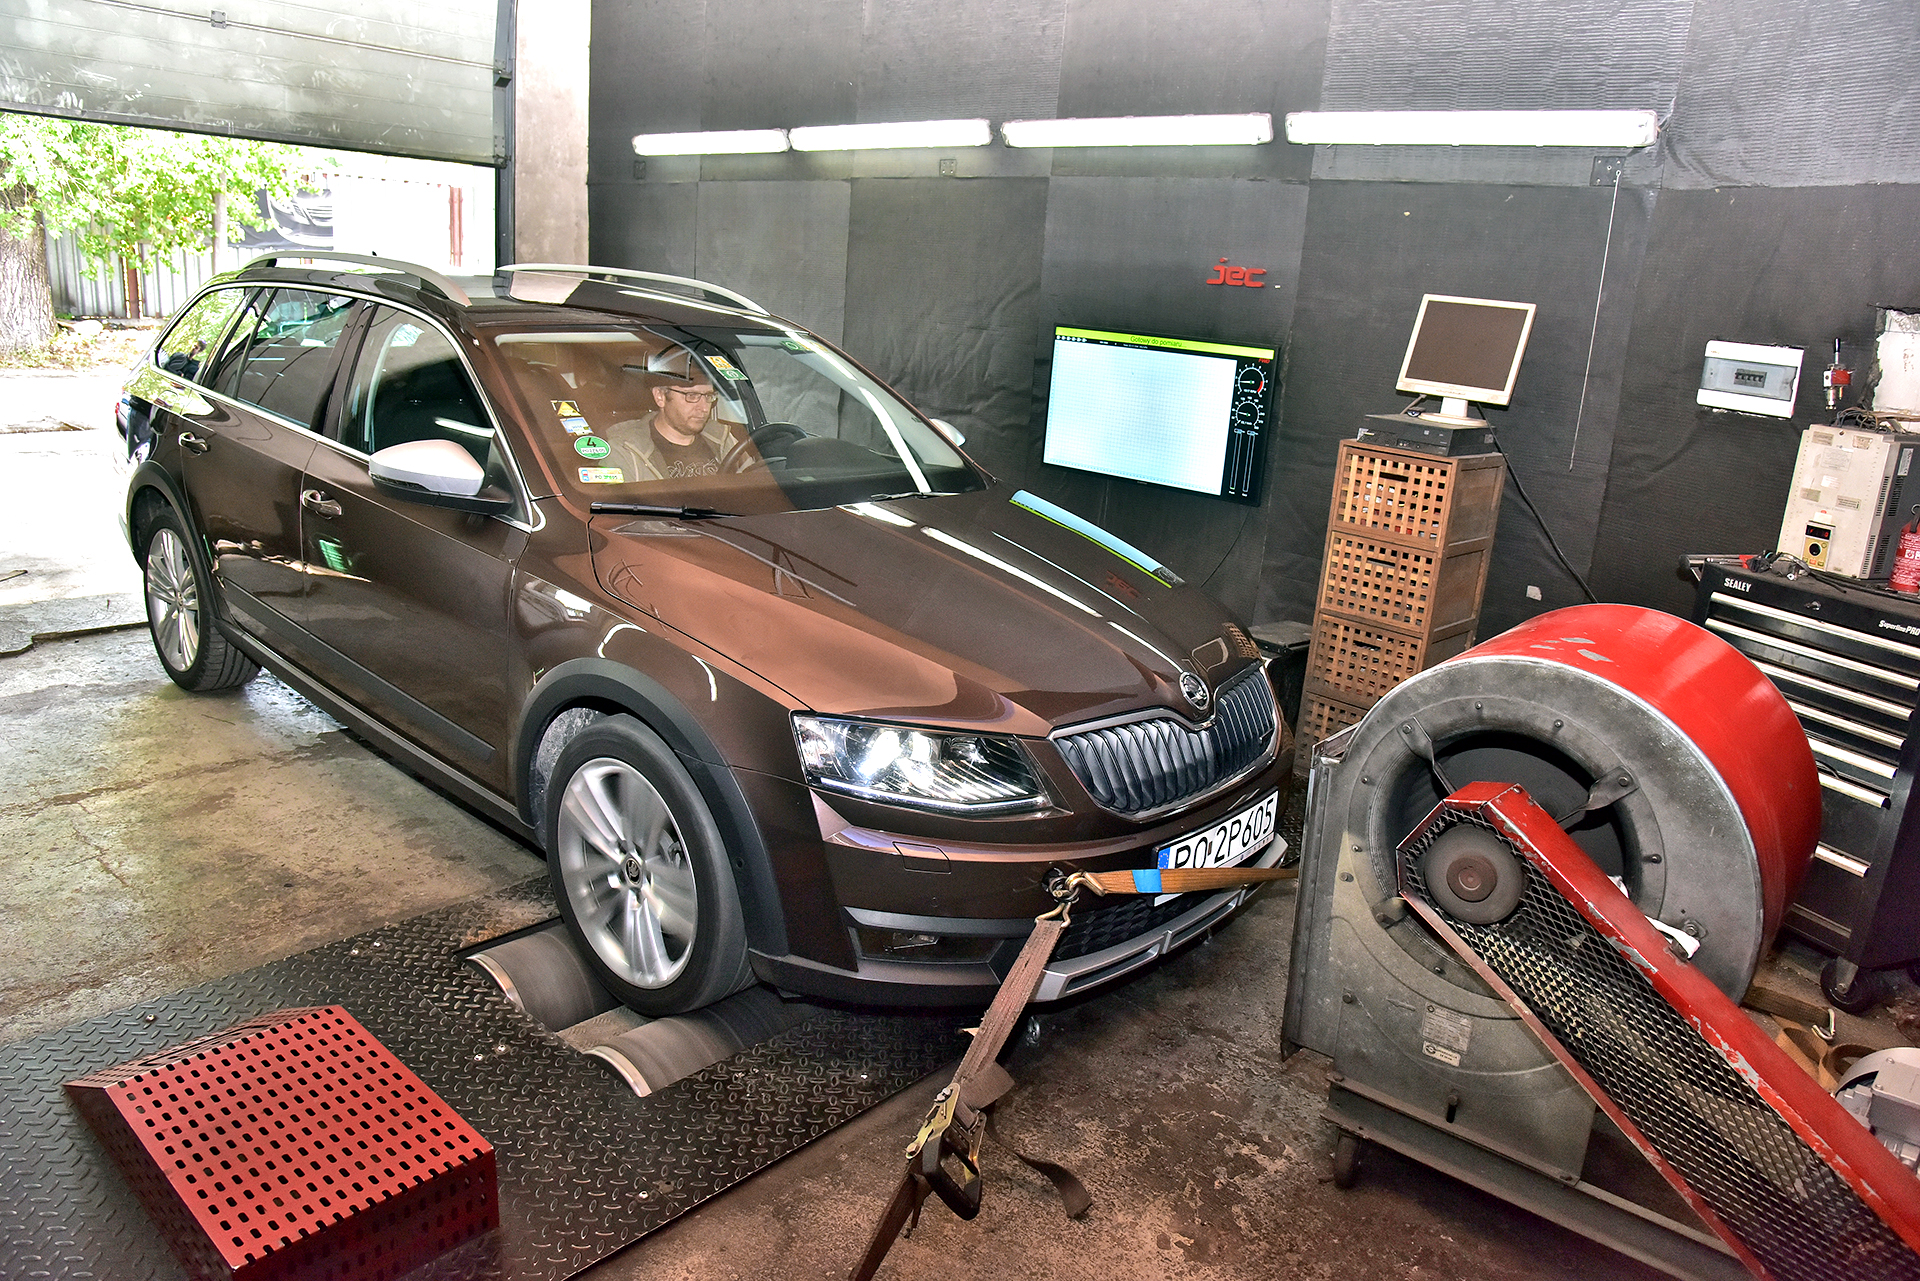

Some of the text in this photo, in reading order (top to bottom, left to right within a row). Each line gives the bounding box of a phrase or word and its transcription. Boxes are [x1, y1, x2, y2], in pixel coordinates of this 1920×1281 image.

[1206, 257, 1266, 288] jec
[1130, 336, 1151, 345] Gotowy
[1724, 577, 1752, 593] SEALEY
[1174, 836, 1208, 869] PO
[1214, 798, 1275, 864] 2P605
